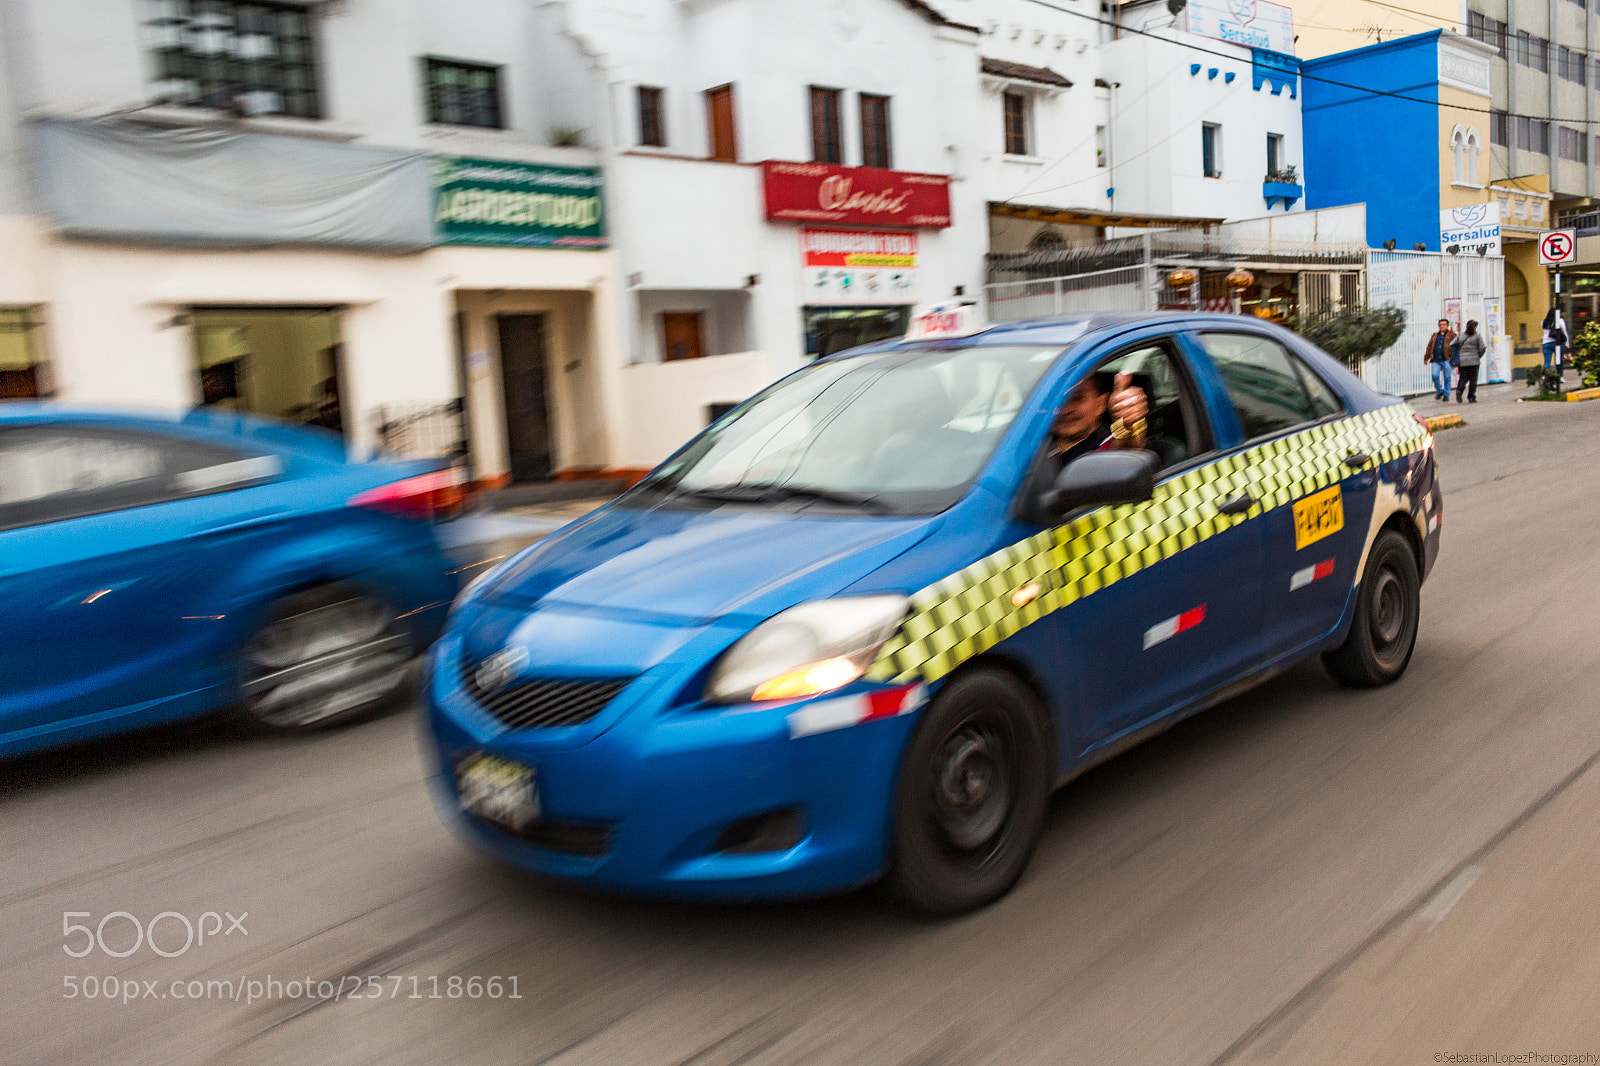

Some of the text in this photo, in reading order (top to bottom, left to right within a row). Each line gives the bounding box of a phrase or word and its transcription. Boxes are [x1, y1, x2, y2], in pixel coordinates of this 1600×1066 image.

[1219, 23, 1270, 48] Sersalud
[1442, 226, 1499, 243] Sersalud
[1550, 238, 1564, 256] E
